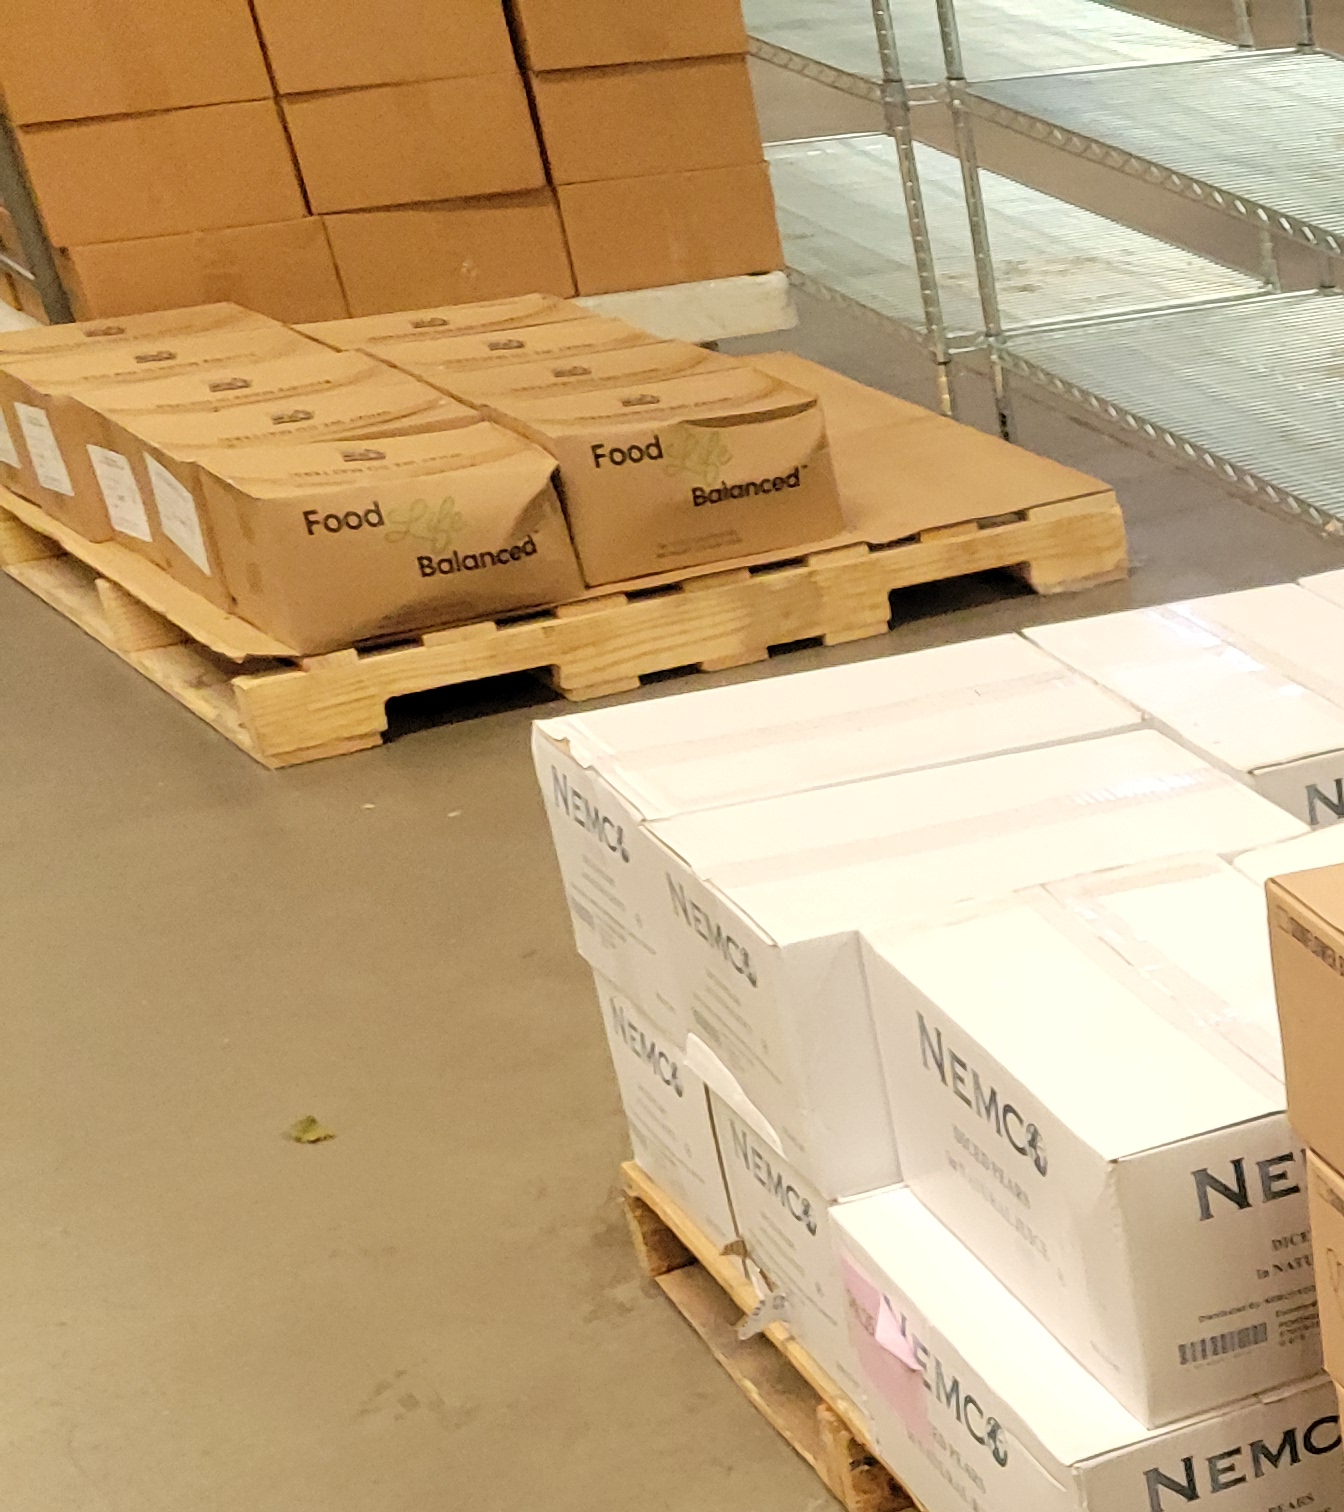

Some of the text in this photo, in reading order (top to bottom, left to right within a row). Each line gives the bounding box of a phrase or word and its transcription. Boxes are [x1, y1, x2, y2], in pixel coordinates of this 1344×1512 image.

[591, 434, 663, 468] Food
[691, 465, 801, 507] Balanced
[303, 500, 384, 535] Food
[417, 535, 538, 577] Balanced
[551, 764, 631, 863] NEMCO
[666, 871, 758, 988] NEMCO
[609, 997, 684, 1098] NEMCO
[917, 1010, 1048, 1178] NEMCO
[729, 1118, 817, 1237] NEMCO
